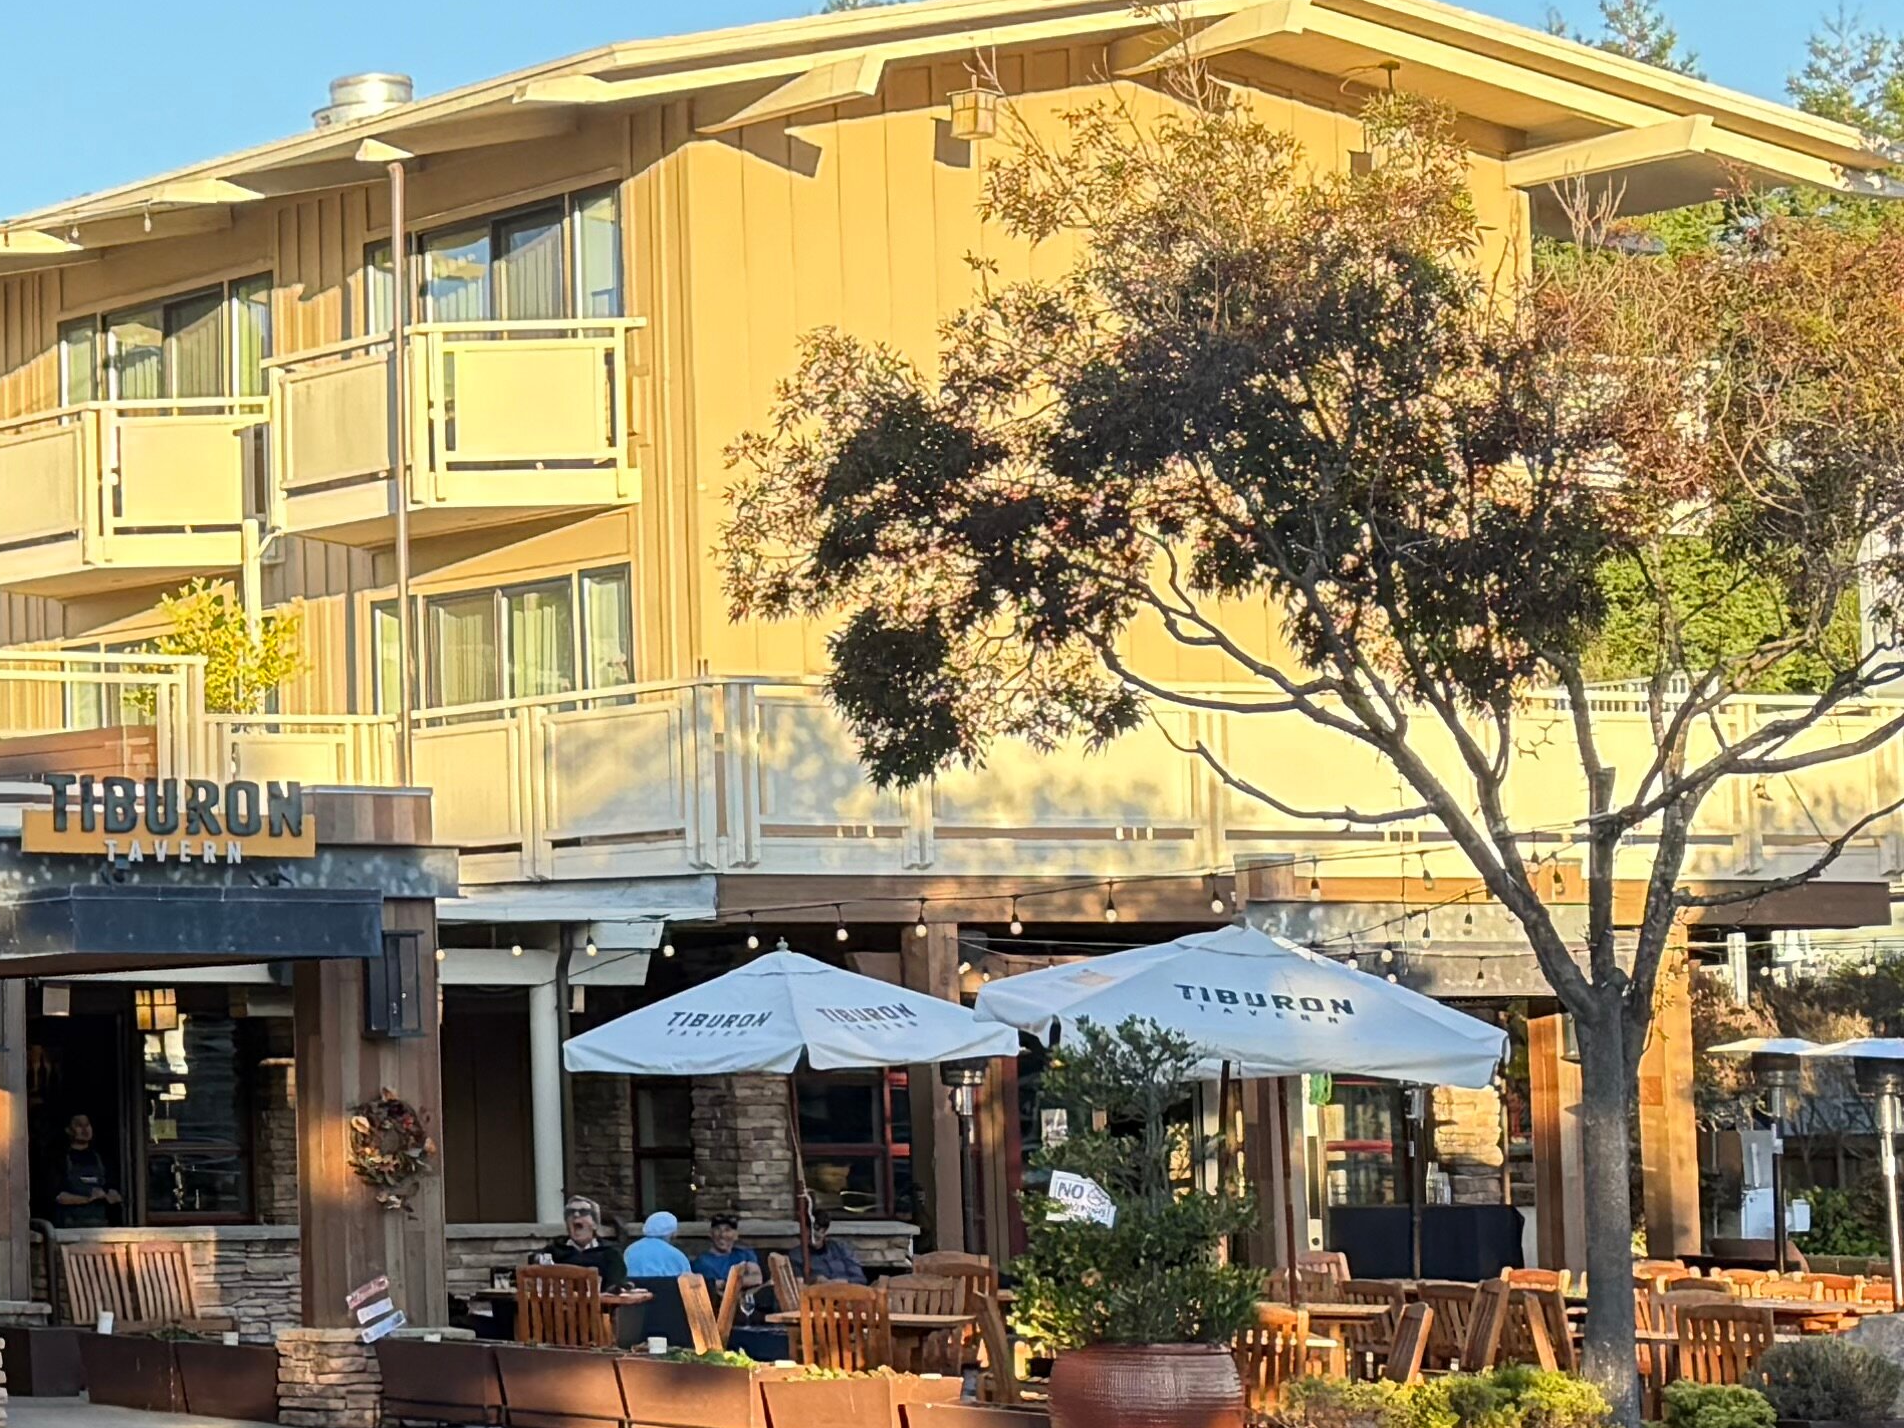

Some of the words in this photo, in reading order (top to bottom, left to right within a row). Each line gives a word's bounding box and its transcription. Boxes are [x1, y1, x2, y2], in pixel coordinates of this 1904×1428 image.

[44, 773, 303, 838] TIBURON
[103, 839, 243, 865] TAVERN
[1174, 983, 1355, 1015] TIBURON
[666, 1011, 773, 1029] TIBURON
[815, 1002, 918, 1024] TIBURON
[1058, 1181, 1085, 1199] NO
